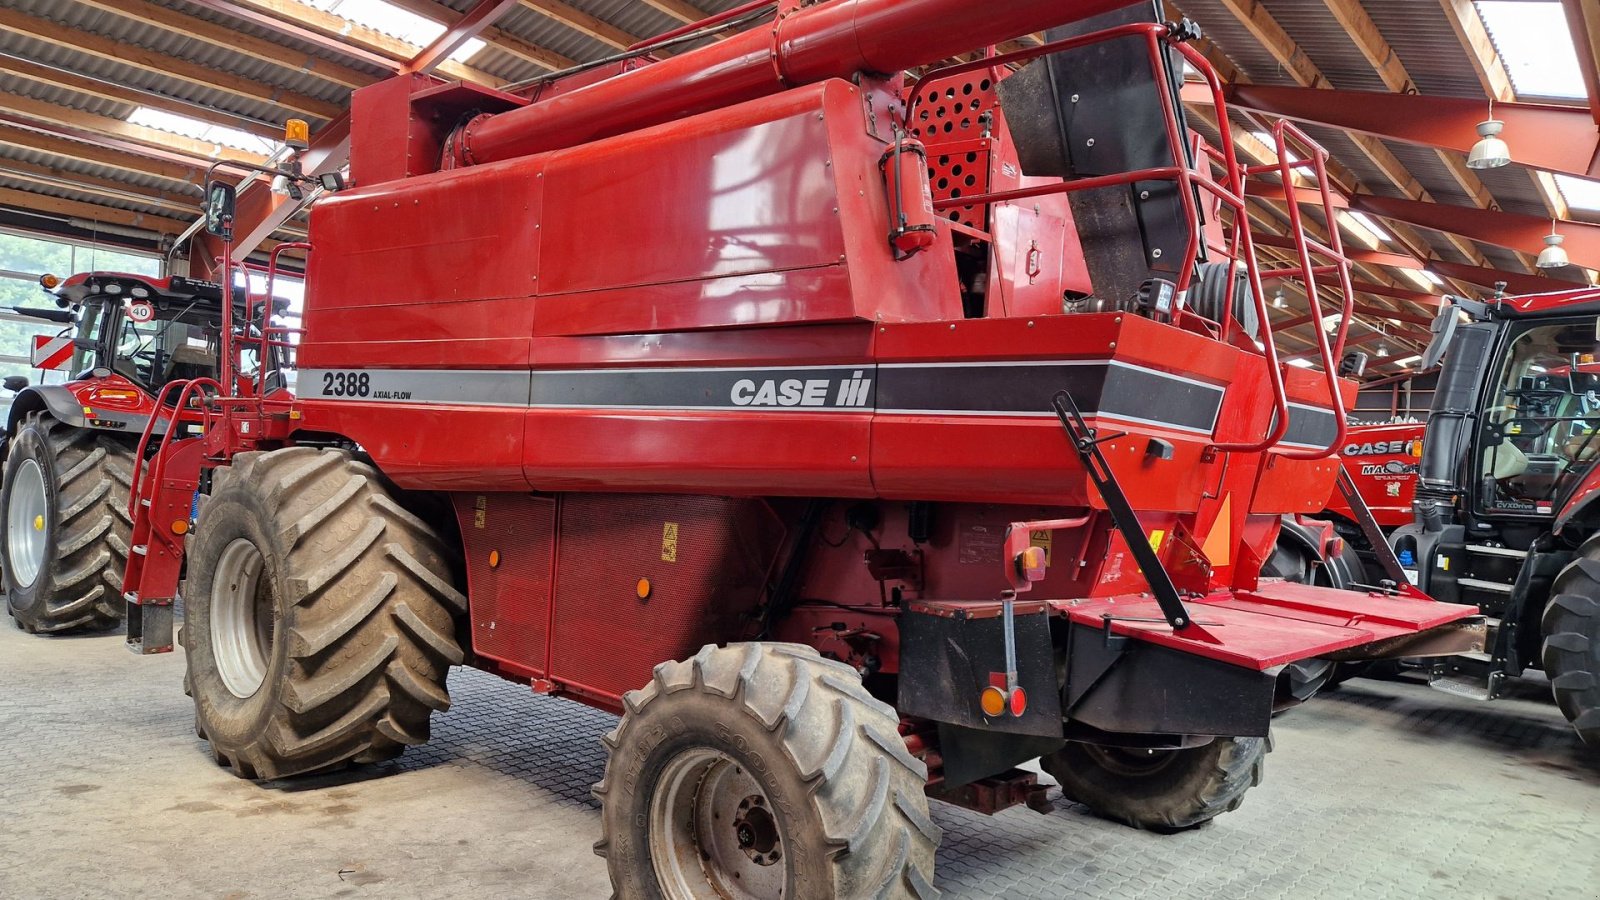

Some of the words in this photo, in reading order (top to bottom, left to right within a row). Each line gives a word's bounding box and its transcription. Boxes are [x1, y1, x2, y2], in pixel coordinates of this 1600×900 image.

[133, 307, 148, 317] 40
[322, 372, 370, 397] 2388
[373, 391, 412, 400] AXIAL-FLOW
[730, 379, 830, 406] CASE
[1344, 441, 1403, 456] CASE
